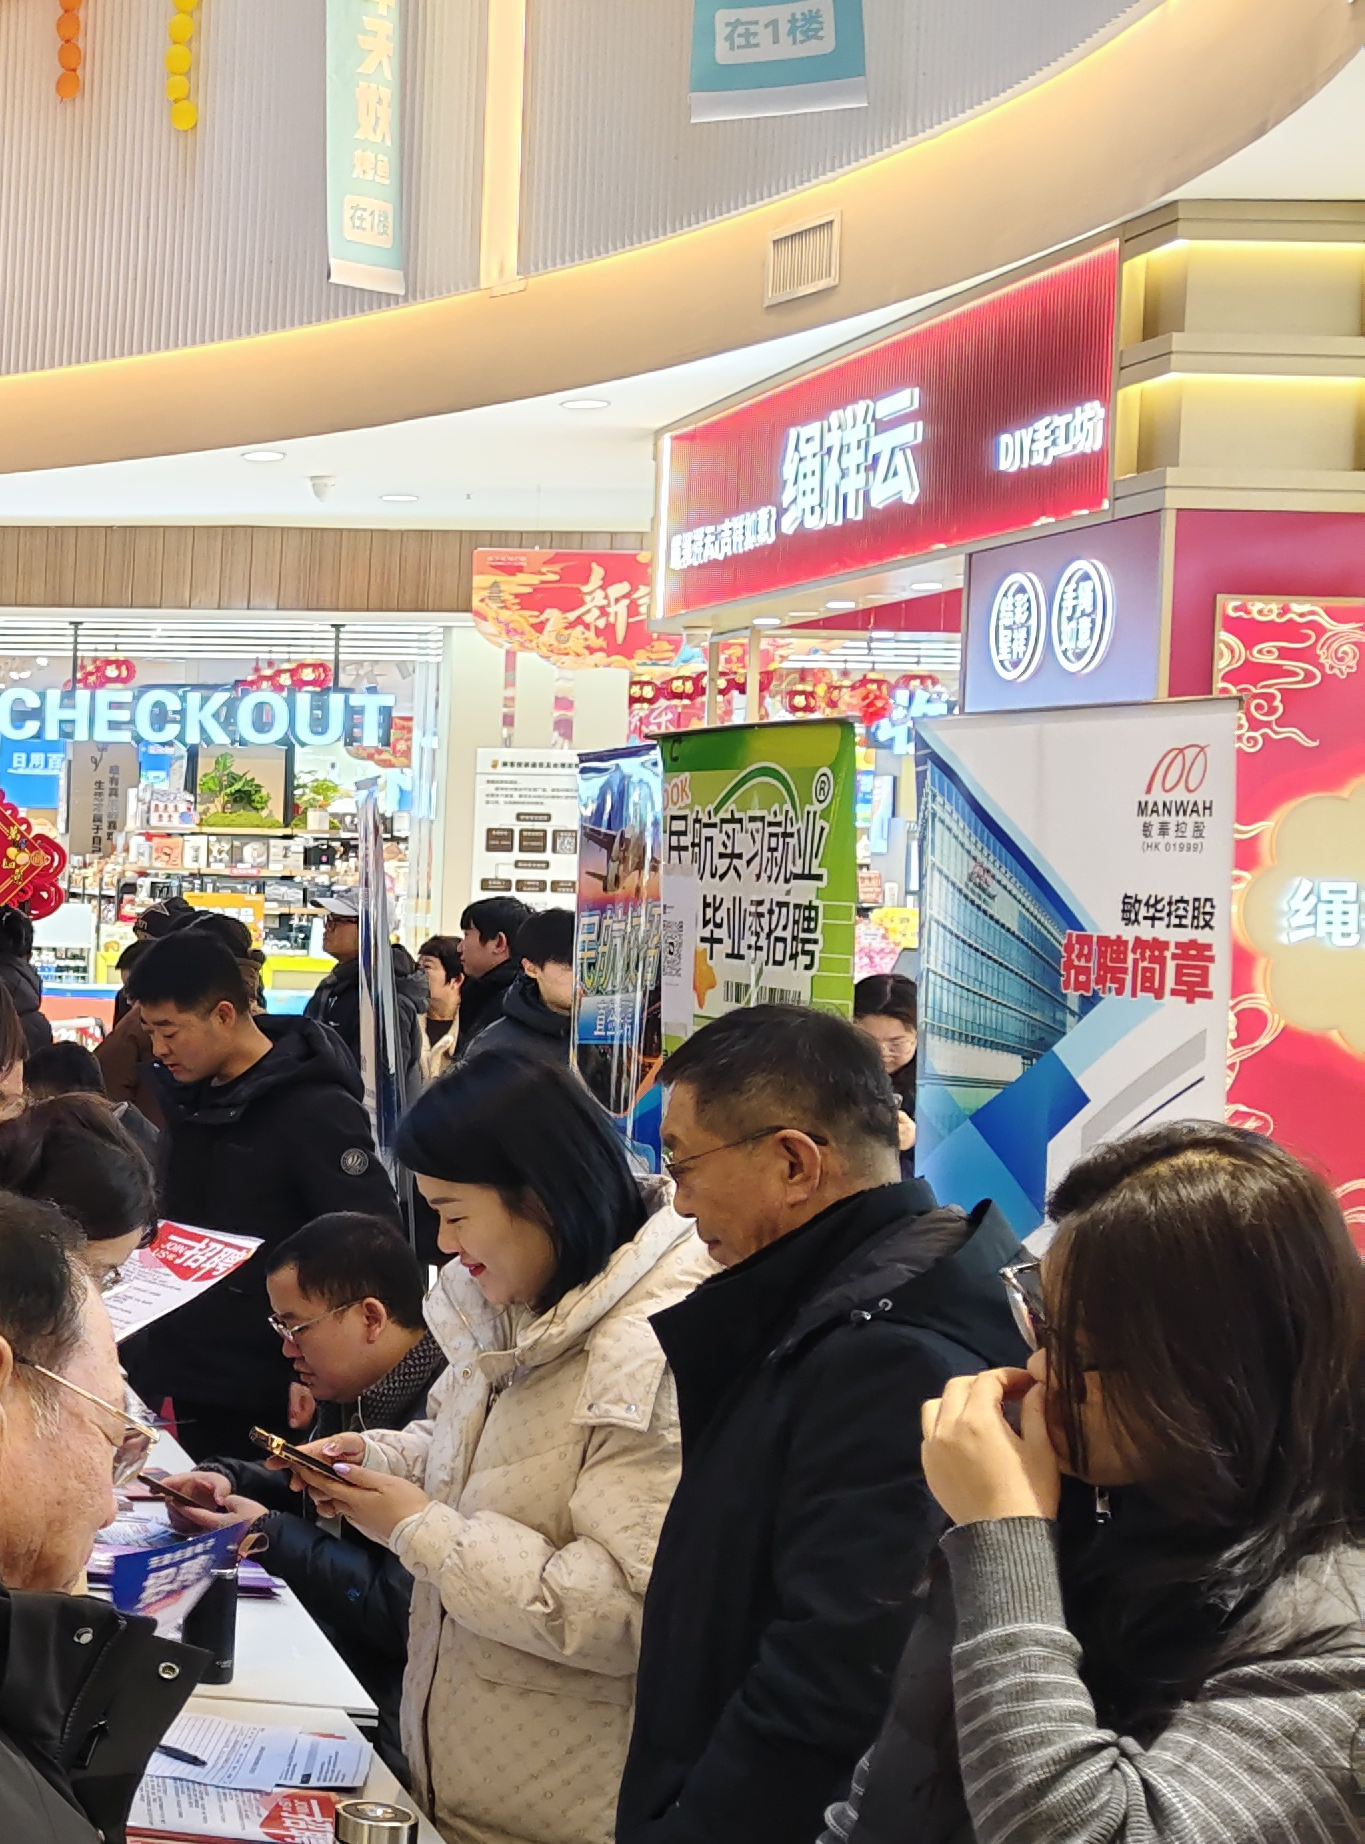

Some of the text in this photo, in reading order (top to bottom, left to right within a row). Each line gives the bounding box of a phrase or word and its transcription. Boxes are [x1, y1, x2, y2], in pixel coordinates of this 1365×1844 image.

[723, 9, 825, 52] 在1楼
[352, 149, 391, 184] 烤鱼
[349, 202, 390, 238] 在1楼
[780, 387, 926, 535] 绳祥云
[1137, 800, 1214, 818] MANWAH
[667, 809, 825, 883] 民航实习就业
[1141, 841, 1204, 854] (HK 01999)
[1142, 821, 1206, 839] 敏華控股
[1121, 893, 1216, 931] 敏华控股
[699, 893, 820, 972] 毕业季招聘
[1060, 930, 1217, 1005] 招聘简章
